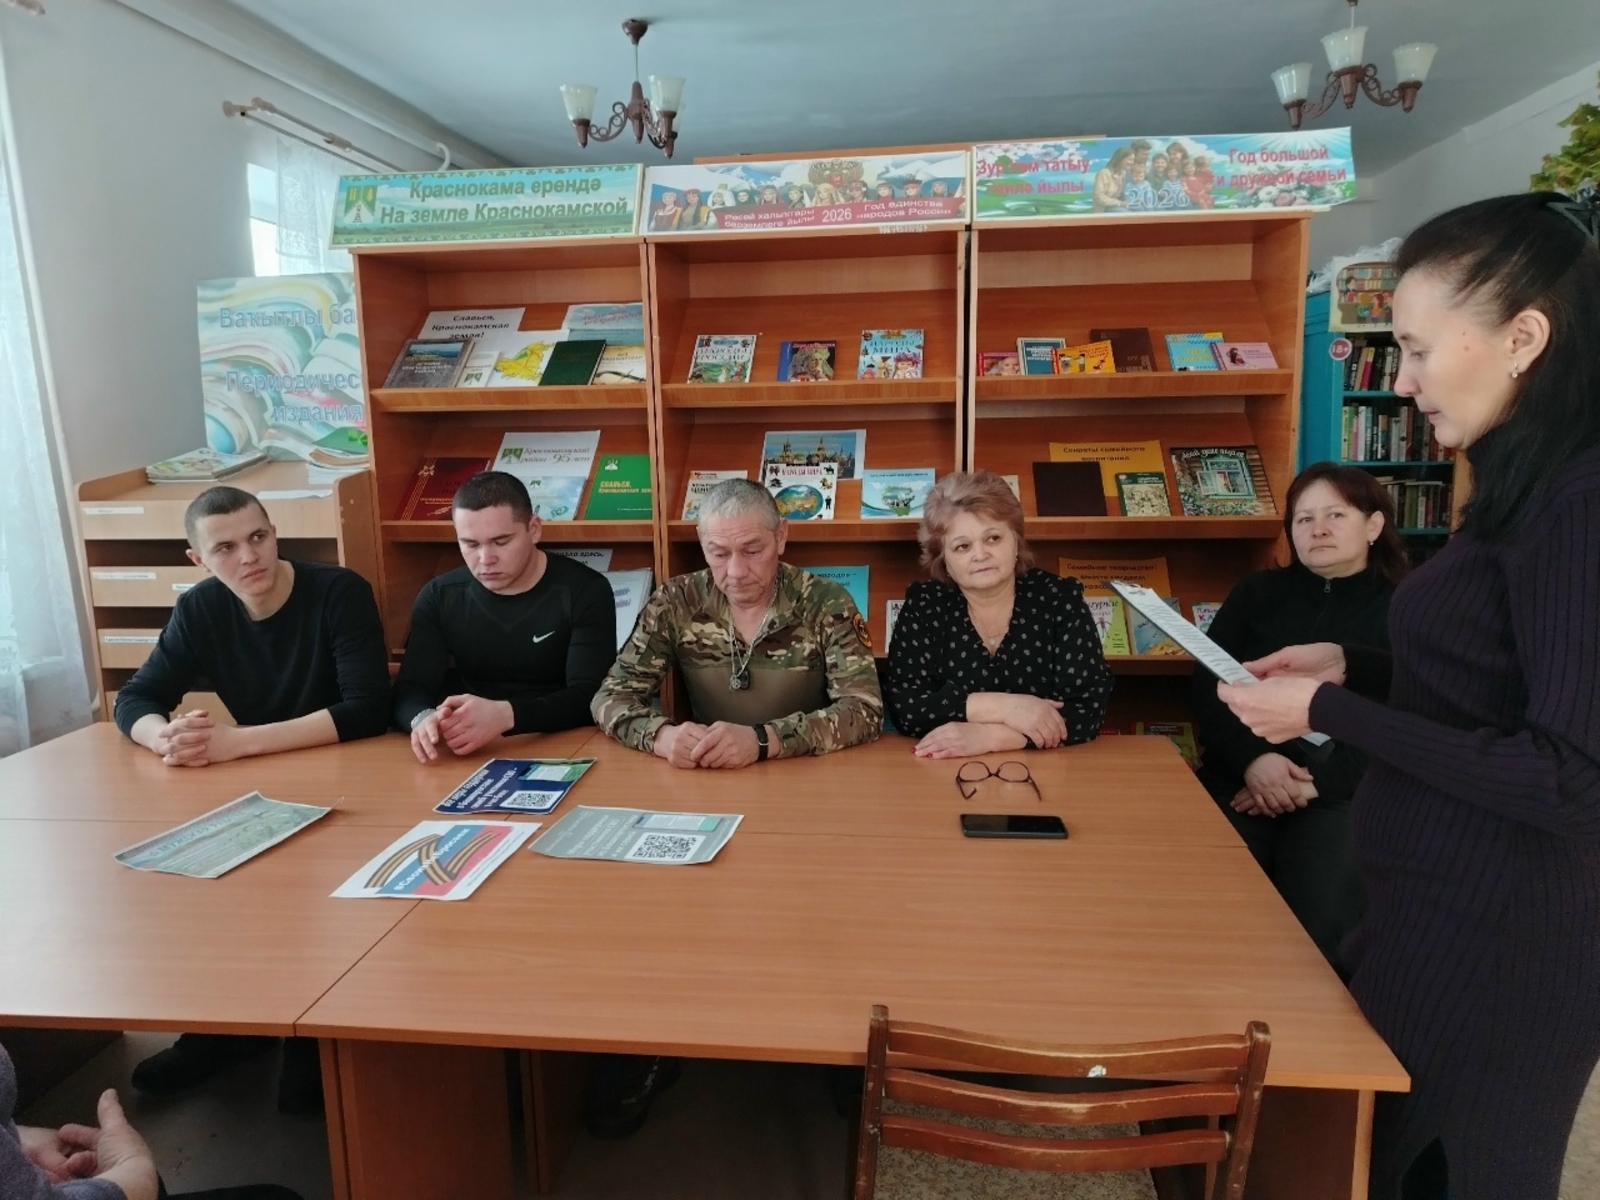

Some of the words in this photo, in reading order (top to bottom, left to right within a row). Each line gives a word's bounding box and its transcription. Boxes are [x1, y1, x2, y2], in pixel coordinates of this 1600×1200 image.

[1229, 148, 1256, 165] Год
[1260, 144, 1328, 162] большой
[976, 159, 1004, 177] Зур
[1043, 159, 1090, 174] татыу
[1038, 180, 1083, 193] йылы
[1217, 175, 1225, 186] и
[1230, 168, 1294, 192] дружной
[1298, 168, 1347, 183] семьи
[410, 181, 525, 203] Краснокама
[1125, 188, 1190, 208] 2026
[380, 206, 405, 224] На
[410, 206, 469, 223] земле
[474, 197, 628, 223] Краснокамской
[857, 209, 905, 219] народов
[909, 208, 951, 216] России
[864, 203, 885, 211] Год
[888, 200, 943, 208] единства
[787, 216, 815, 225] йылы
[821, 208, 852, 223] 2026
[431, 323, 510, 331] Краснокамская
[1331, 344, 1349, 354] 18+
[226, 370, 361, 396] Периодичес
[273, 404, 362, 424] издания
[553, 453, 571, 464] 95
